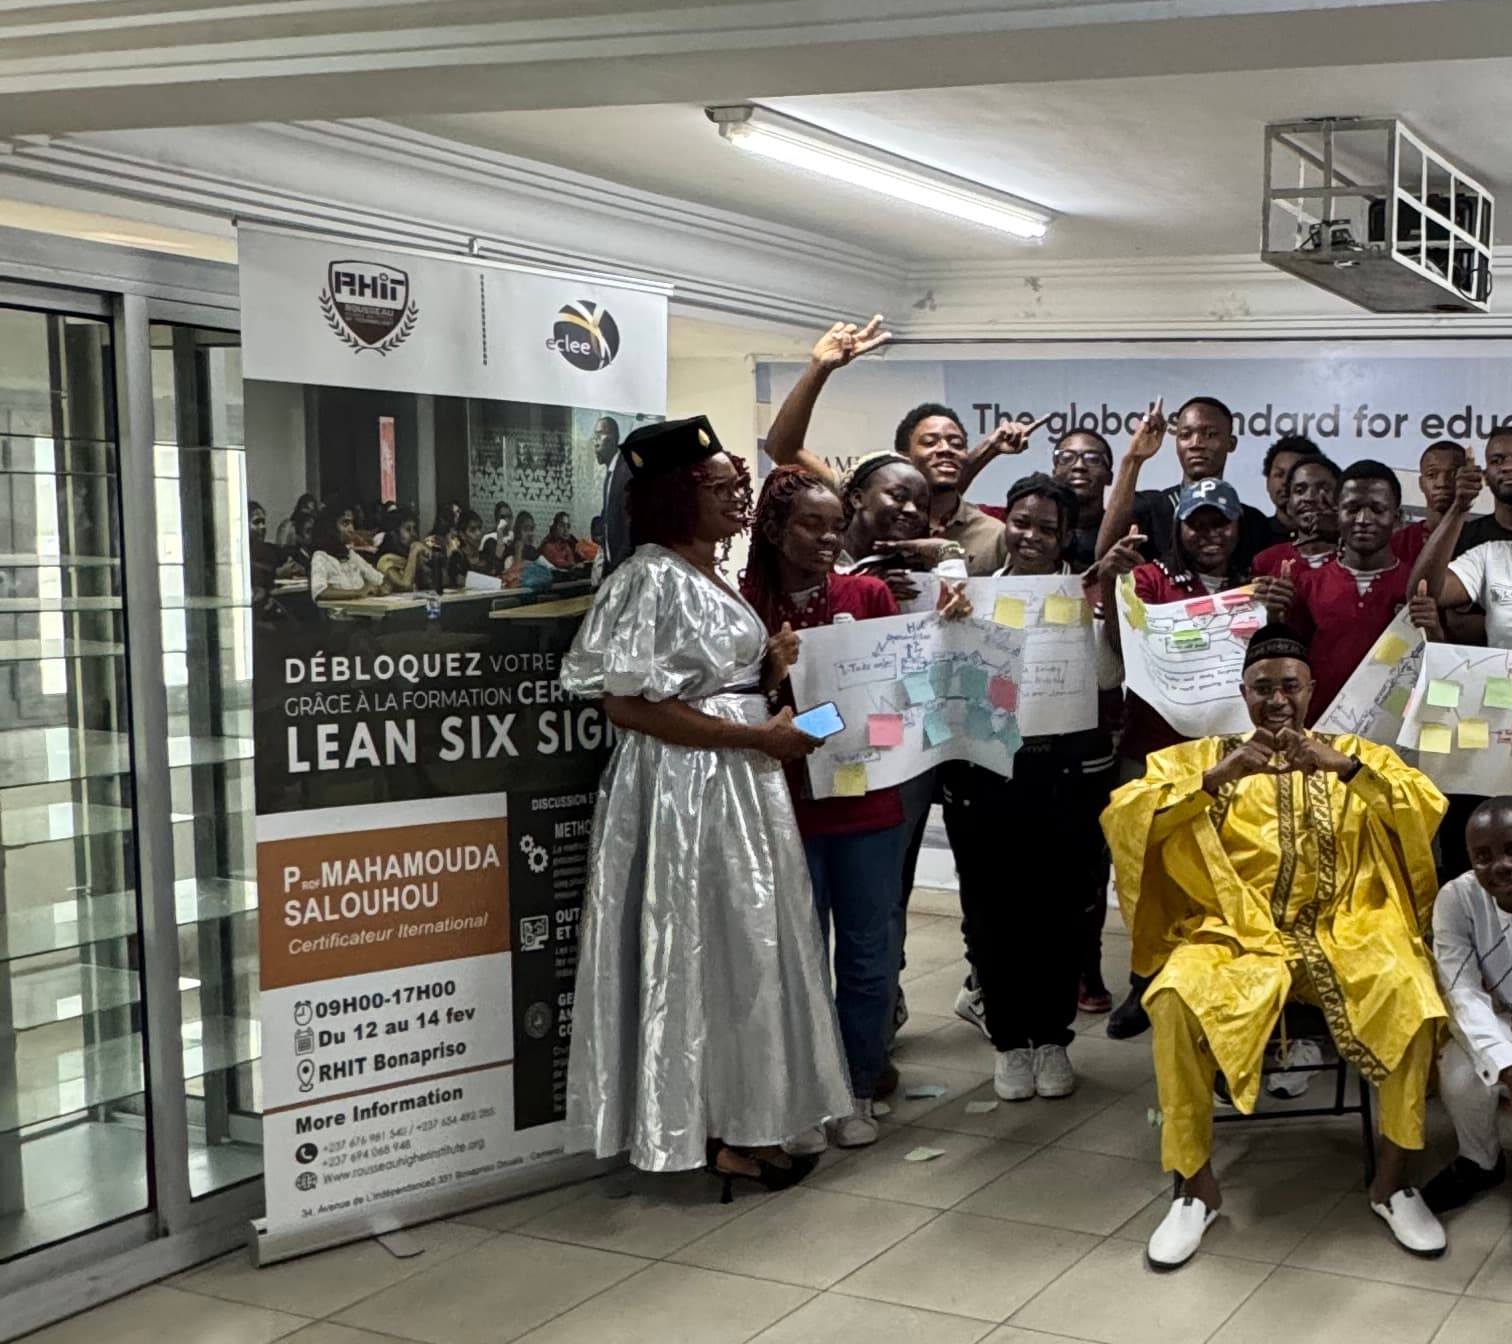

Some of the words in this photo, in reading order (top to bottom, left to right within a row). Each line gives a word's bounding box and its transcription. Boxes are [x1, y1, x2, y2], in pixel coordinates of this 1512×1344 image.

[546, 338, 590, 355] eclee
[972, 403, 1032, 434] The
[1353, 404, 1408, 439] for
[285, 650, 482, 683] DÉBLOQUEZ
[489, 653, 555, 674] VOTRE
[285, 692, 351, 716] GRÂCE
[355, 689, 371, 712] À
[375, 692, 398, 711] LA
[403, 687, 511, 710] FORMATION
[287, 718, 416, 774] LEAN
[439, 713, 519, 762] SIX
[531, 793, 587, 811] DISCUSSION
[321, 843, 500, 888] MAHAMOUDA
[284, 881, 439, 927] SALOUHOU
[288, 927, 394, 955] Certificateur
[398, 912, 489, 939] Iternational
[315, 980, 456, 1018] 09H00-17H00
[319, 1030, 345, 1047] Du
[353, 1022, 378, 1040] 12
[385, 1019, 409, 1035] au
[416, 1010, 440, 1029] 14
[446, 1007, 476, 1024] fev
[318, 1057, 367, 1082] RHIT
[373, 1041, 466, 1072] Bonapriso
[295, 1111, 345, 1134] More
[353, 1087, 463, 1122] Information
